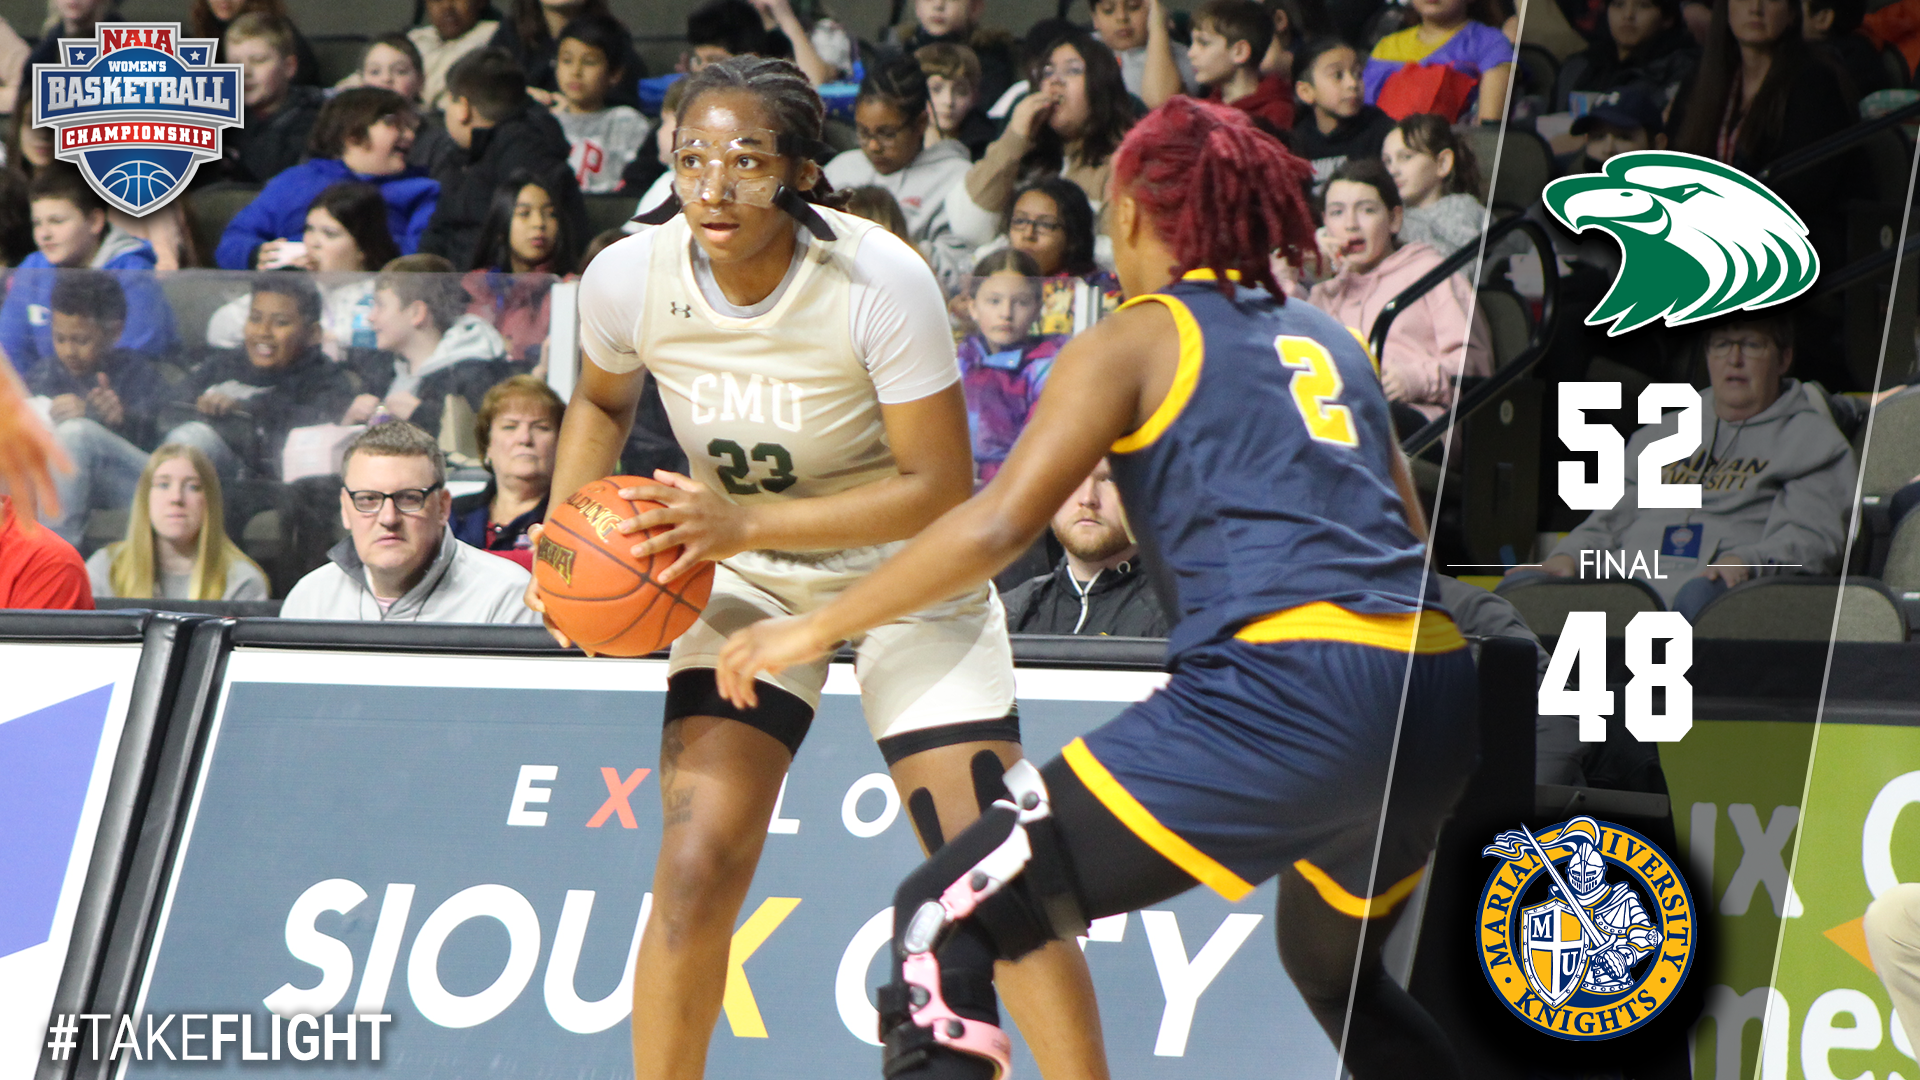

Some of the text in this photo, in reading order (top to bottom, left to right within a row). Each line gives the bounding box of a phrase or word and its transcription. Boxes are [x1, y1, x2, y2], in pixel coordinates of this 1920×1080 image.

[690, 371, 803, 432] CMU
[1273, 335, 1359, 447] 2
[707, 438, 797, 494] 23
